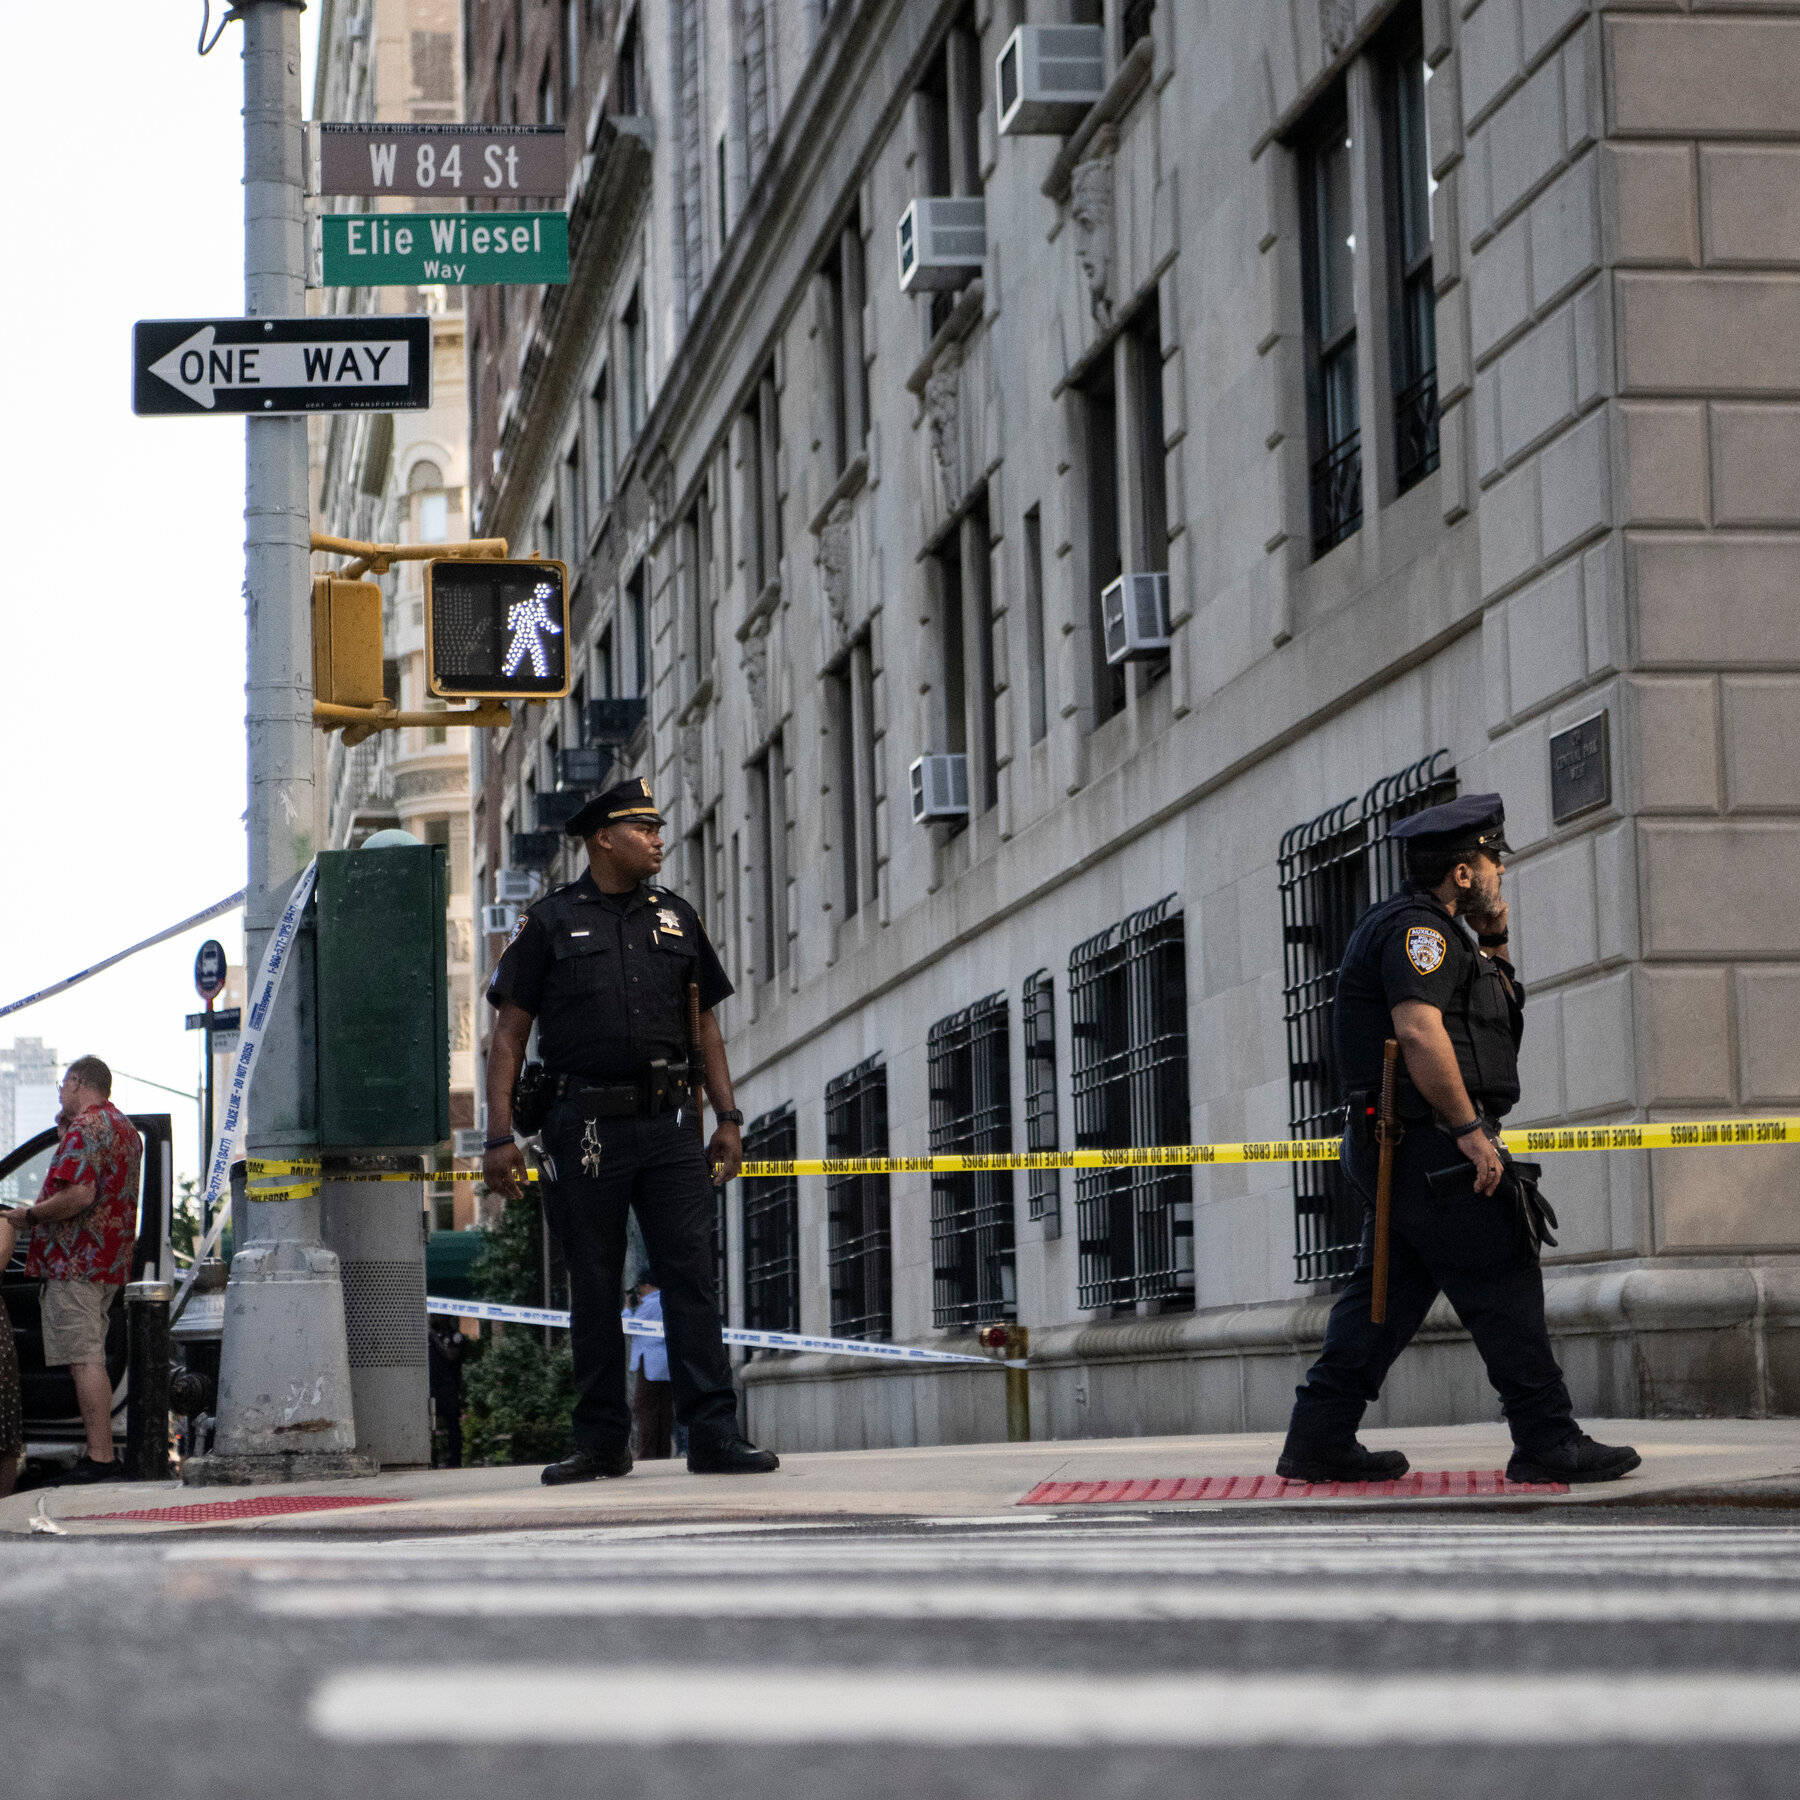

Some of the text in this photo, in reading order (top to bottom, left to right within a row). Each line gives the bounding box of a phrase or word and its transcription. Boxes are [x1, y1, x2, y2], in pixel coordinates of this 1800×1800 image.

[326, 125, 359, 134] UPPER
[362, 125, 388, 134] WEST
[391, 125, 415, 134] SIDE
[492, 125, 538, 134] DISTRICT
[369, 143, 519, 189] W 84 St
[348, 217, 541, 255] Elie Wiesel
[423, 260, 466, 283] Way
[179, 346, 391, 385] ONE WAY
[240, 1042, 256, 1065] CROSS
[236, 1064, 247, 1080] NOT
[233, 1077, 245, 1089] DO
[229, 1093, 242, 1111] LINE
[223, 1108, 236, 1132] POLICE
[1527, 1129, 1642, 1150] POLICE LINE DO NOT CROSS
[1671, 1122, 1786, 1144] POLICE LINE DO NOT CROSS
[1102, 1146, 1215, 1164] POLICE LINE DO NOT CROSS
[1243, 1144, 1270, 1160] CROSS
[1273, 1143, 1289, 1160] NOT
[1292, 1142, 1303, 1158] DO
[1306, 1142, 1324, 1158] LINE
[822, 1157, 933, 1172] POLICE LINE DO NOT CROSS
[962, 1152, 1074, 1168] POLICE LINE DO NOT CROSS
